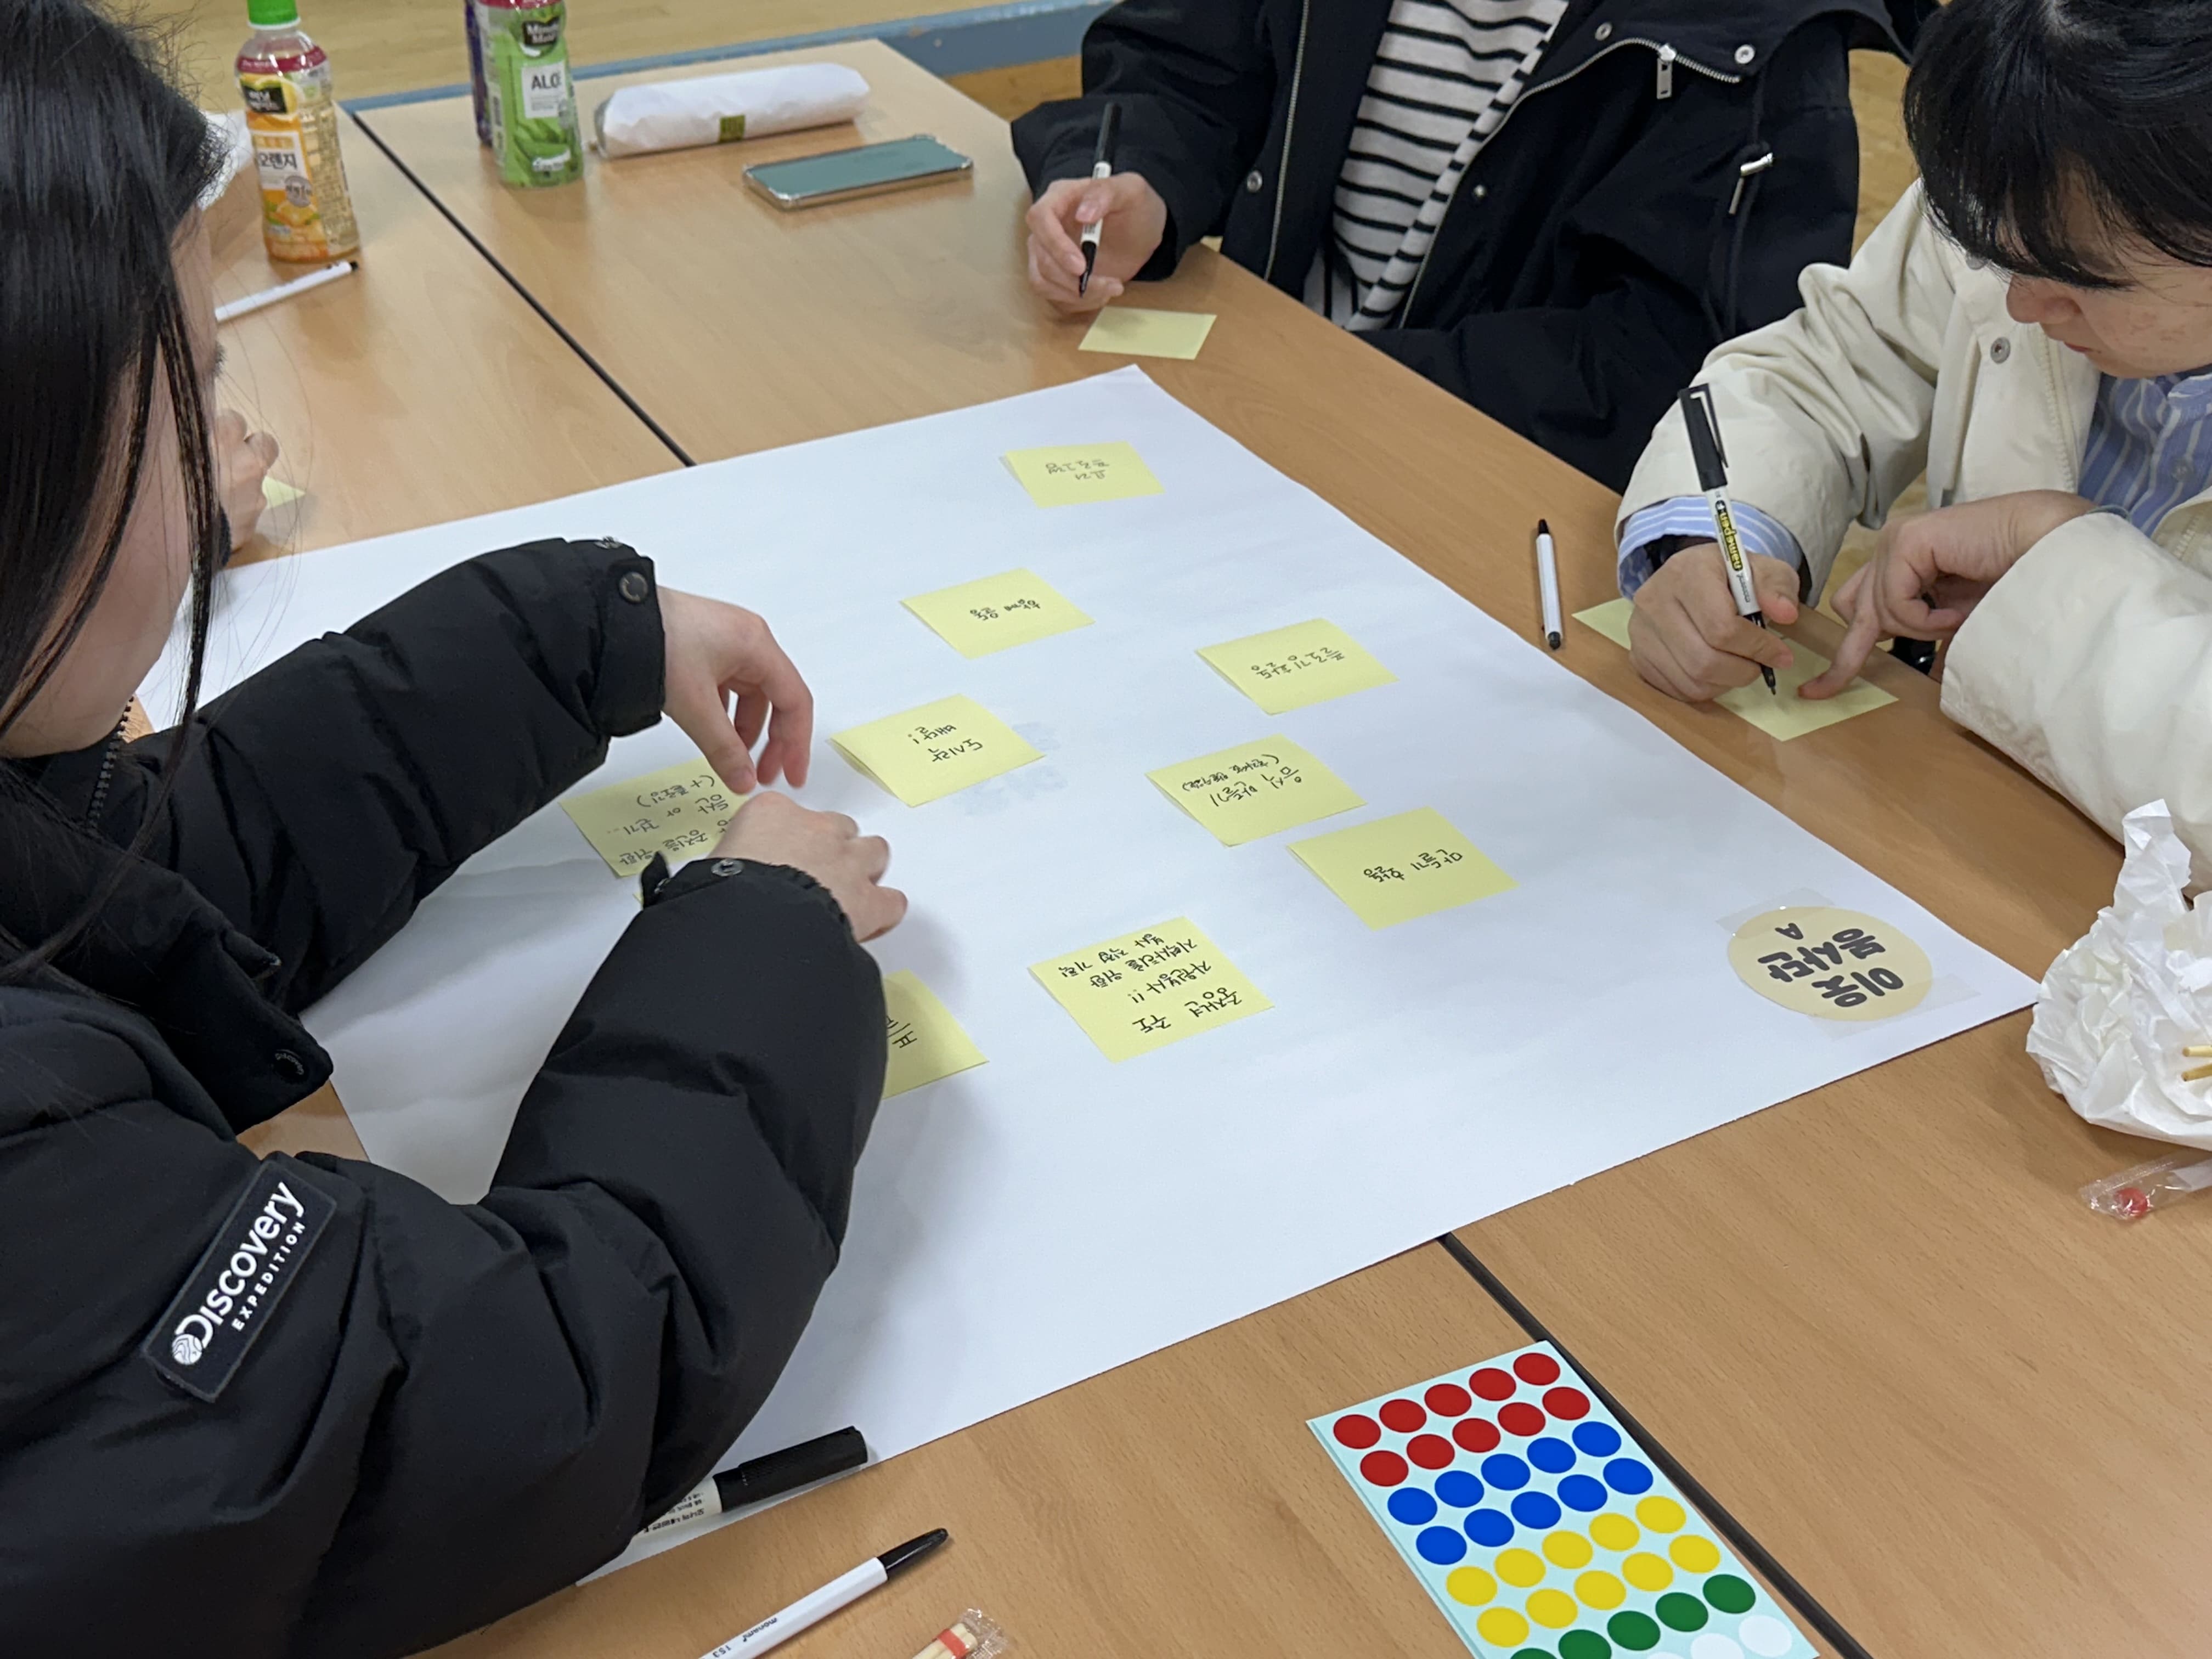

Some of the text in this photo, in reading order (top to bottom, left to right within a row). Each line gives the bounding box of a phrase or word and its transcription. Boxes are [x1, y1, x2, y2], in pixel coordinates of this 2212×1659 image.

[258, 151, 298, 170] 오렌지
[1719, 511, 1742, 569] namepen
[928, 738, 984, 763] 도시락
[1209, 766, 1302, 808] 음식 만들기
[695, 794, 729, 815] 등산
[663, 830, 709, 852] 증진을
[619, 849, 653, 866] 위한
[1363, 849, 1463, 883] 만들기 활동
[1775, 923, 1804, 940] A
[1058, 933, 1165, 978] 봉사 직접 기획
[1757, 928, 1886, 983] 봉사단
[1089, 967, 1123, 989] 위한
[1811, 967, 1904, 1008] 이웃
[1132, 988, 1243, 1034] 중장년 주도
[232, 1221, 306, 1332] EXPEDITION
[712, 1644, 732, 1658] 153
